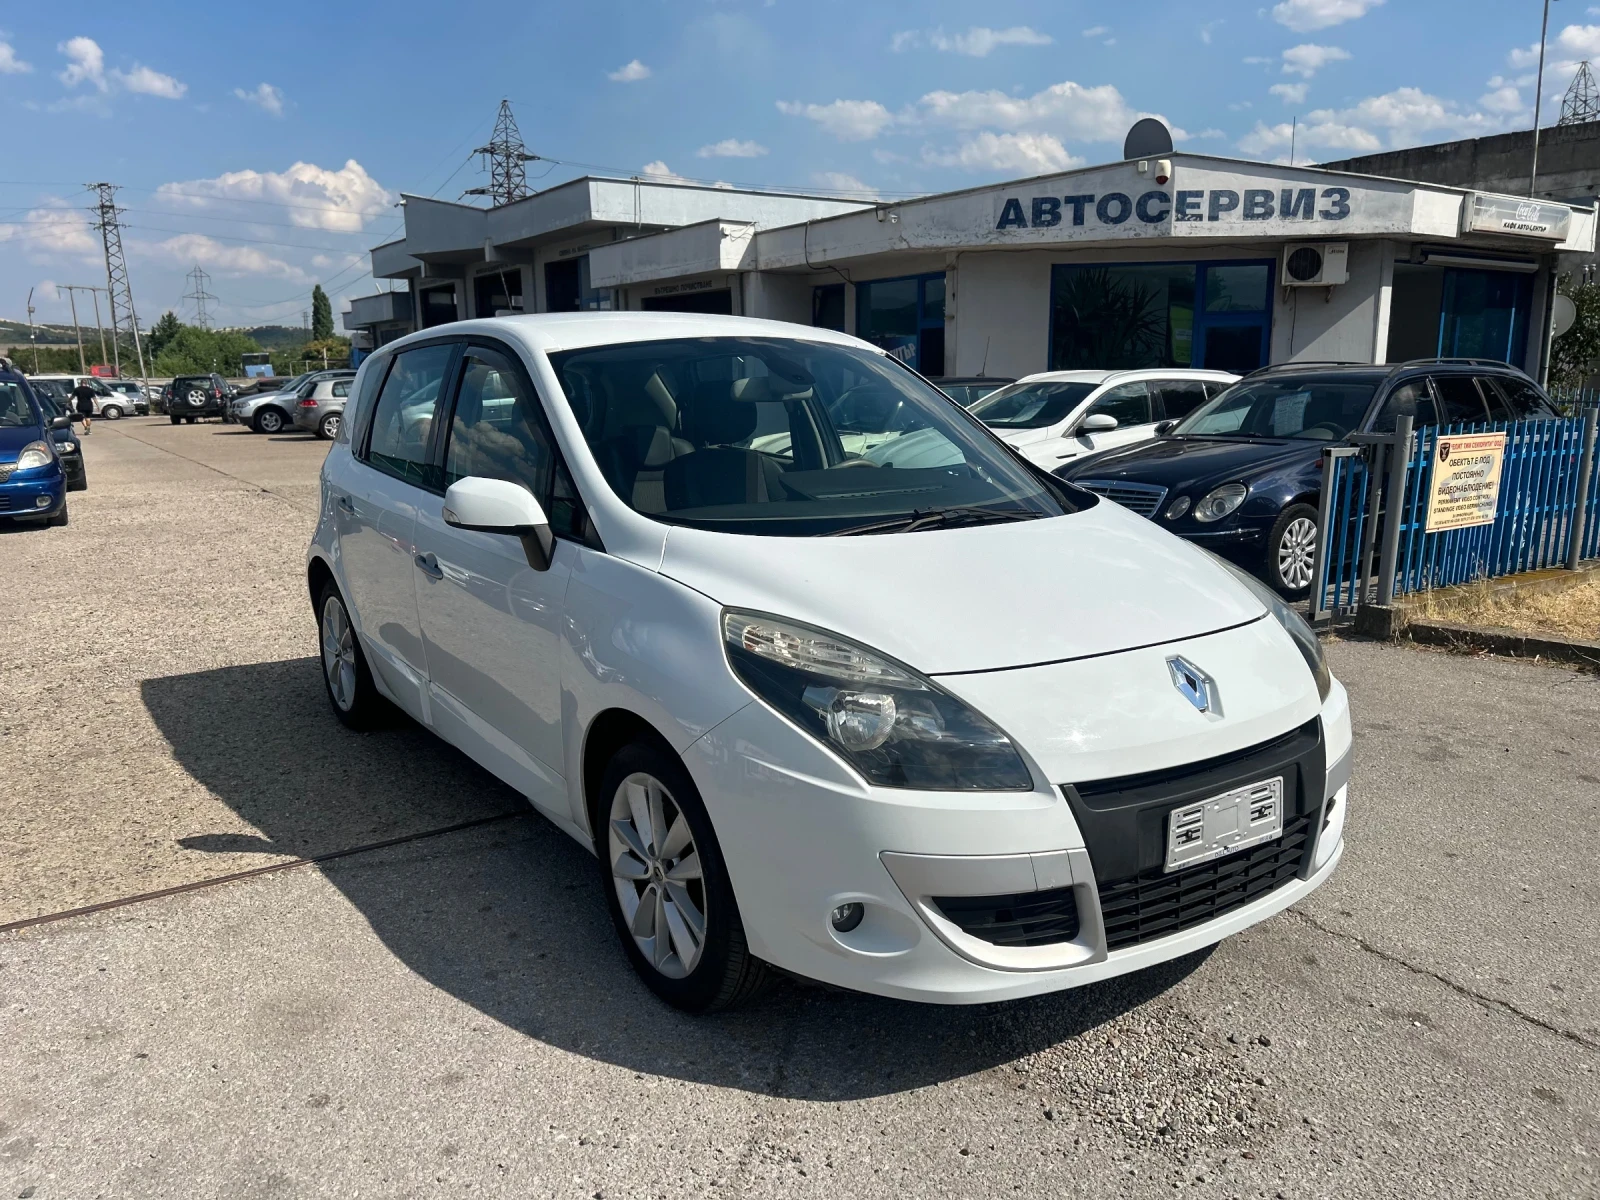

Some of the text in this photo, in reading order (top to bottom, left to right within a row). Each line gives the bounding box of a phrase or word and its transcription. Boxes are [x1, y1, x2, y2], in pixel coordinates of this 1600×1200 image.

[995, 187, 1351, 230] АВТОСЕРВИЗ
[1503, 222, 1517, 230] КАФЕ
[681, 280, 712, 292] ПОЧИСТВАНЕ
[1449, 457, 1474, 467] ОБЕКТЪТ
[1479, 455, 1490, 465] ПОД
[1452, 470, 1484, 480] ПОСТОЯННО
[1438, 482, 1493, 495] ВИДЕОНАБЛЮДЕНИЕ!
